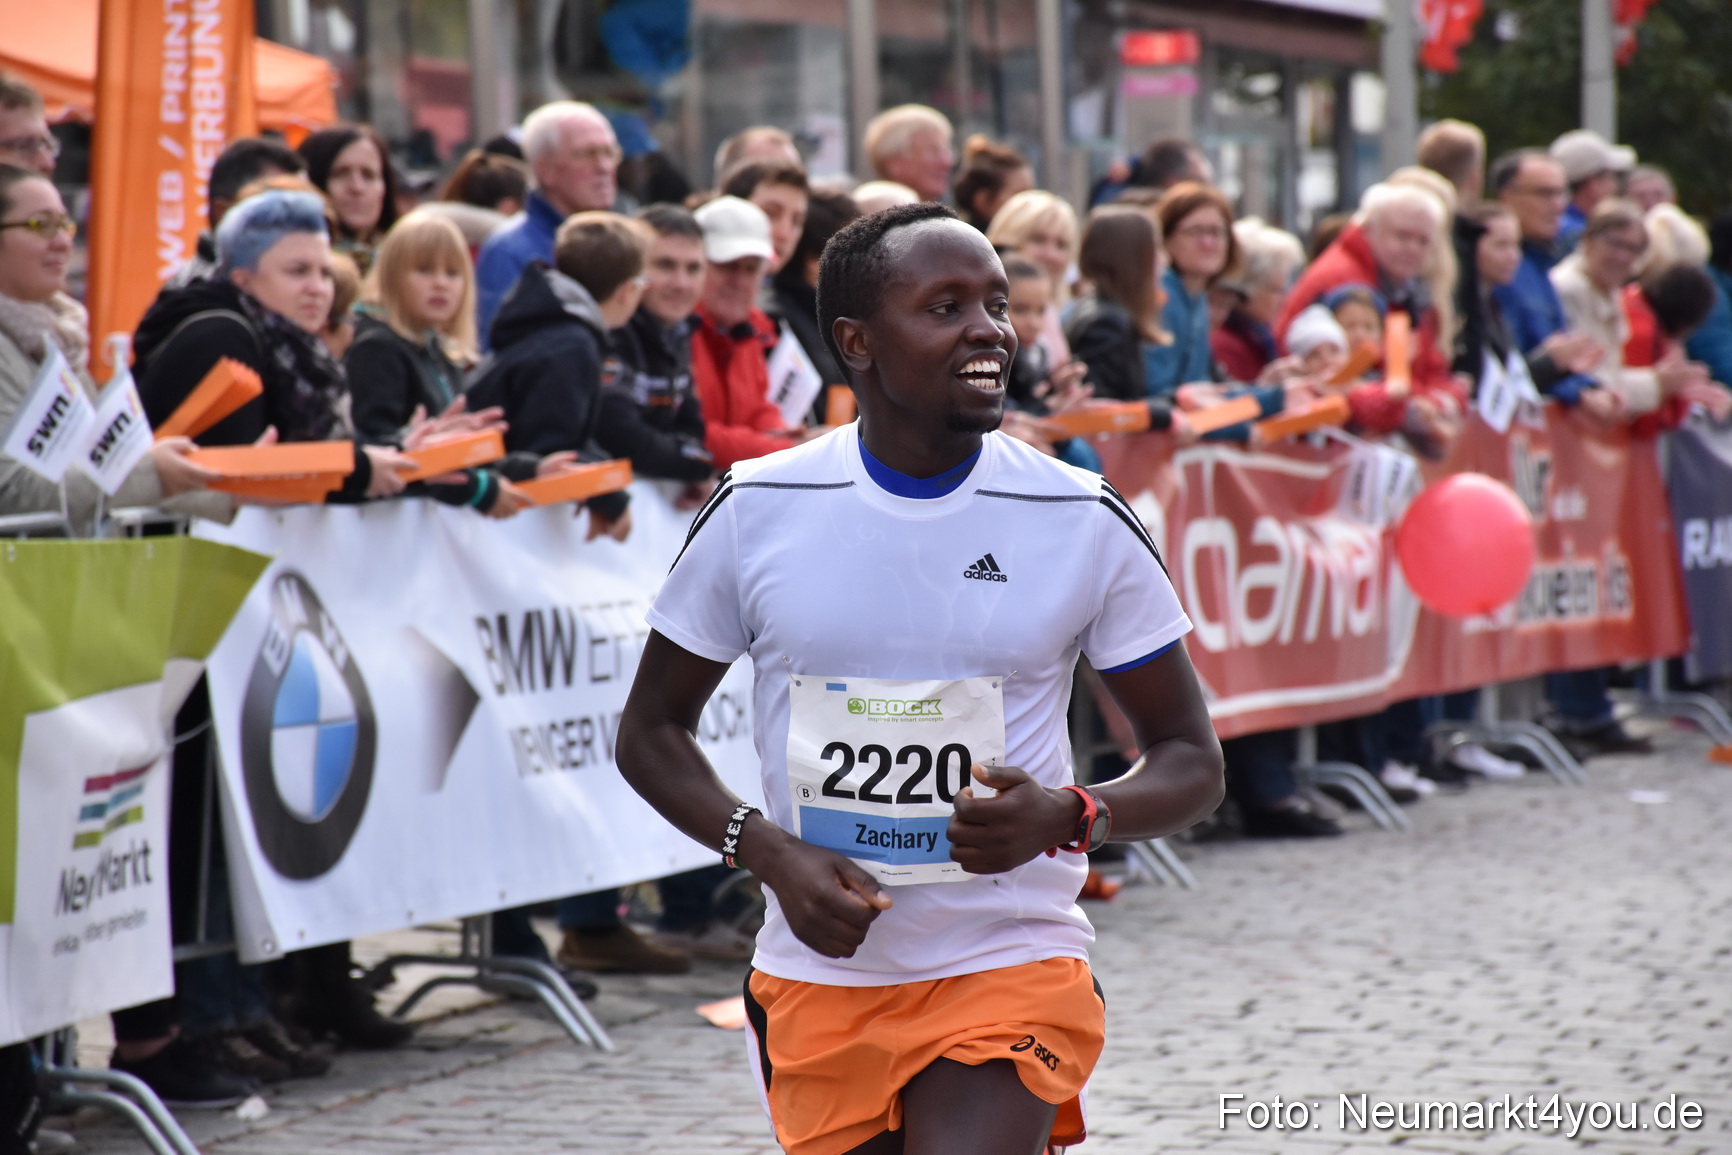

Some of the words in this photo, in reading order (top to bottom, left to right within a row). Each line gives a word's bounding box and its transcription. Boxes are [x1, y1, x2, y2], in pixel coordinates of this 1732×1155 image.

[157, 169, 187, 280] WEB
[26, 394, 70, 457] swn
[88, 411, 132, 467] swn
[963, 568, 1008, 583] adidas
[474, 606, 577, 696] BMW
[867, 698, 943, 716] BOCK
[867, 715, 891, 723] inspired
[918, 715, 944, 723] concepts
[820, 741, 972, 804] 2220
[802, 788, 810, 798] B
[855, 823, 938, 853] Zachary
[1034, 1043, 1060, 1071] asics
